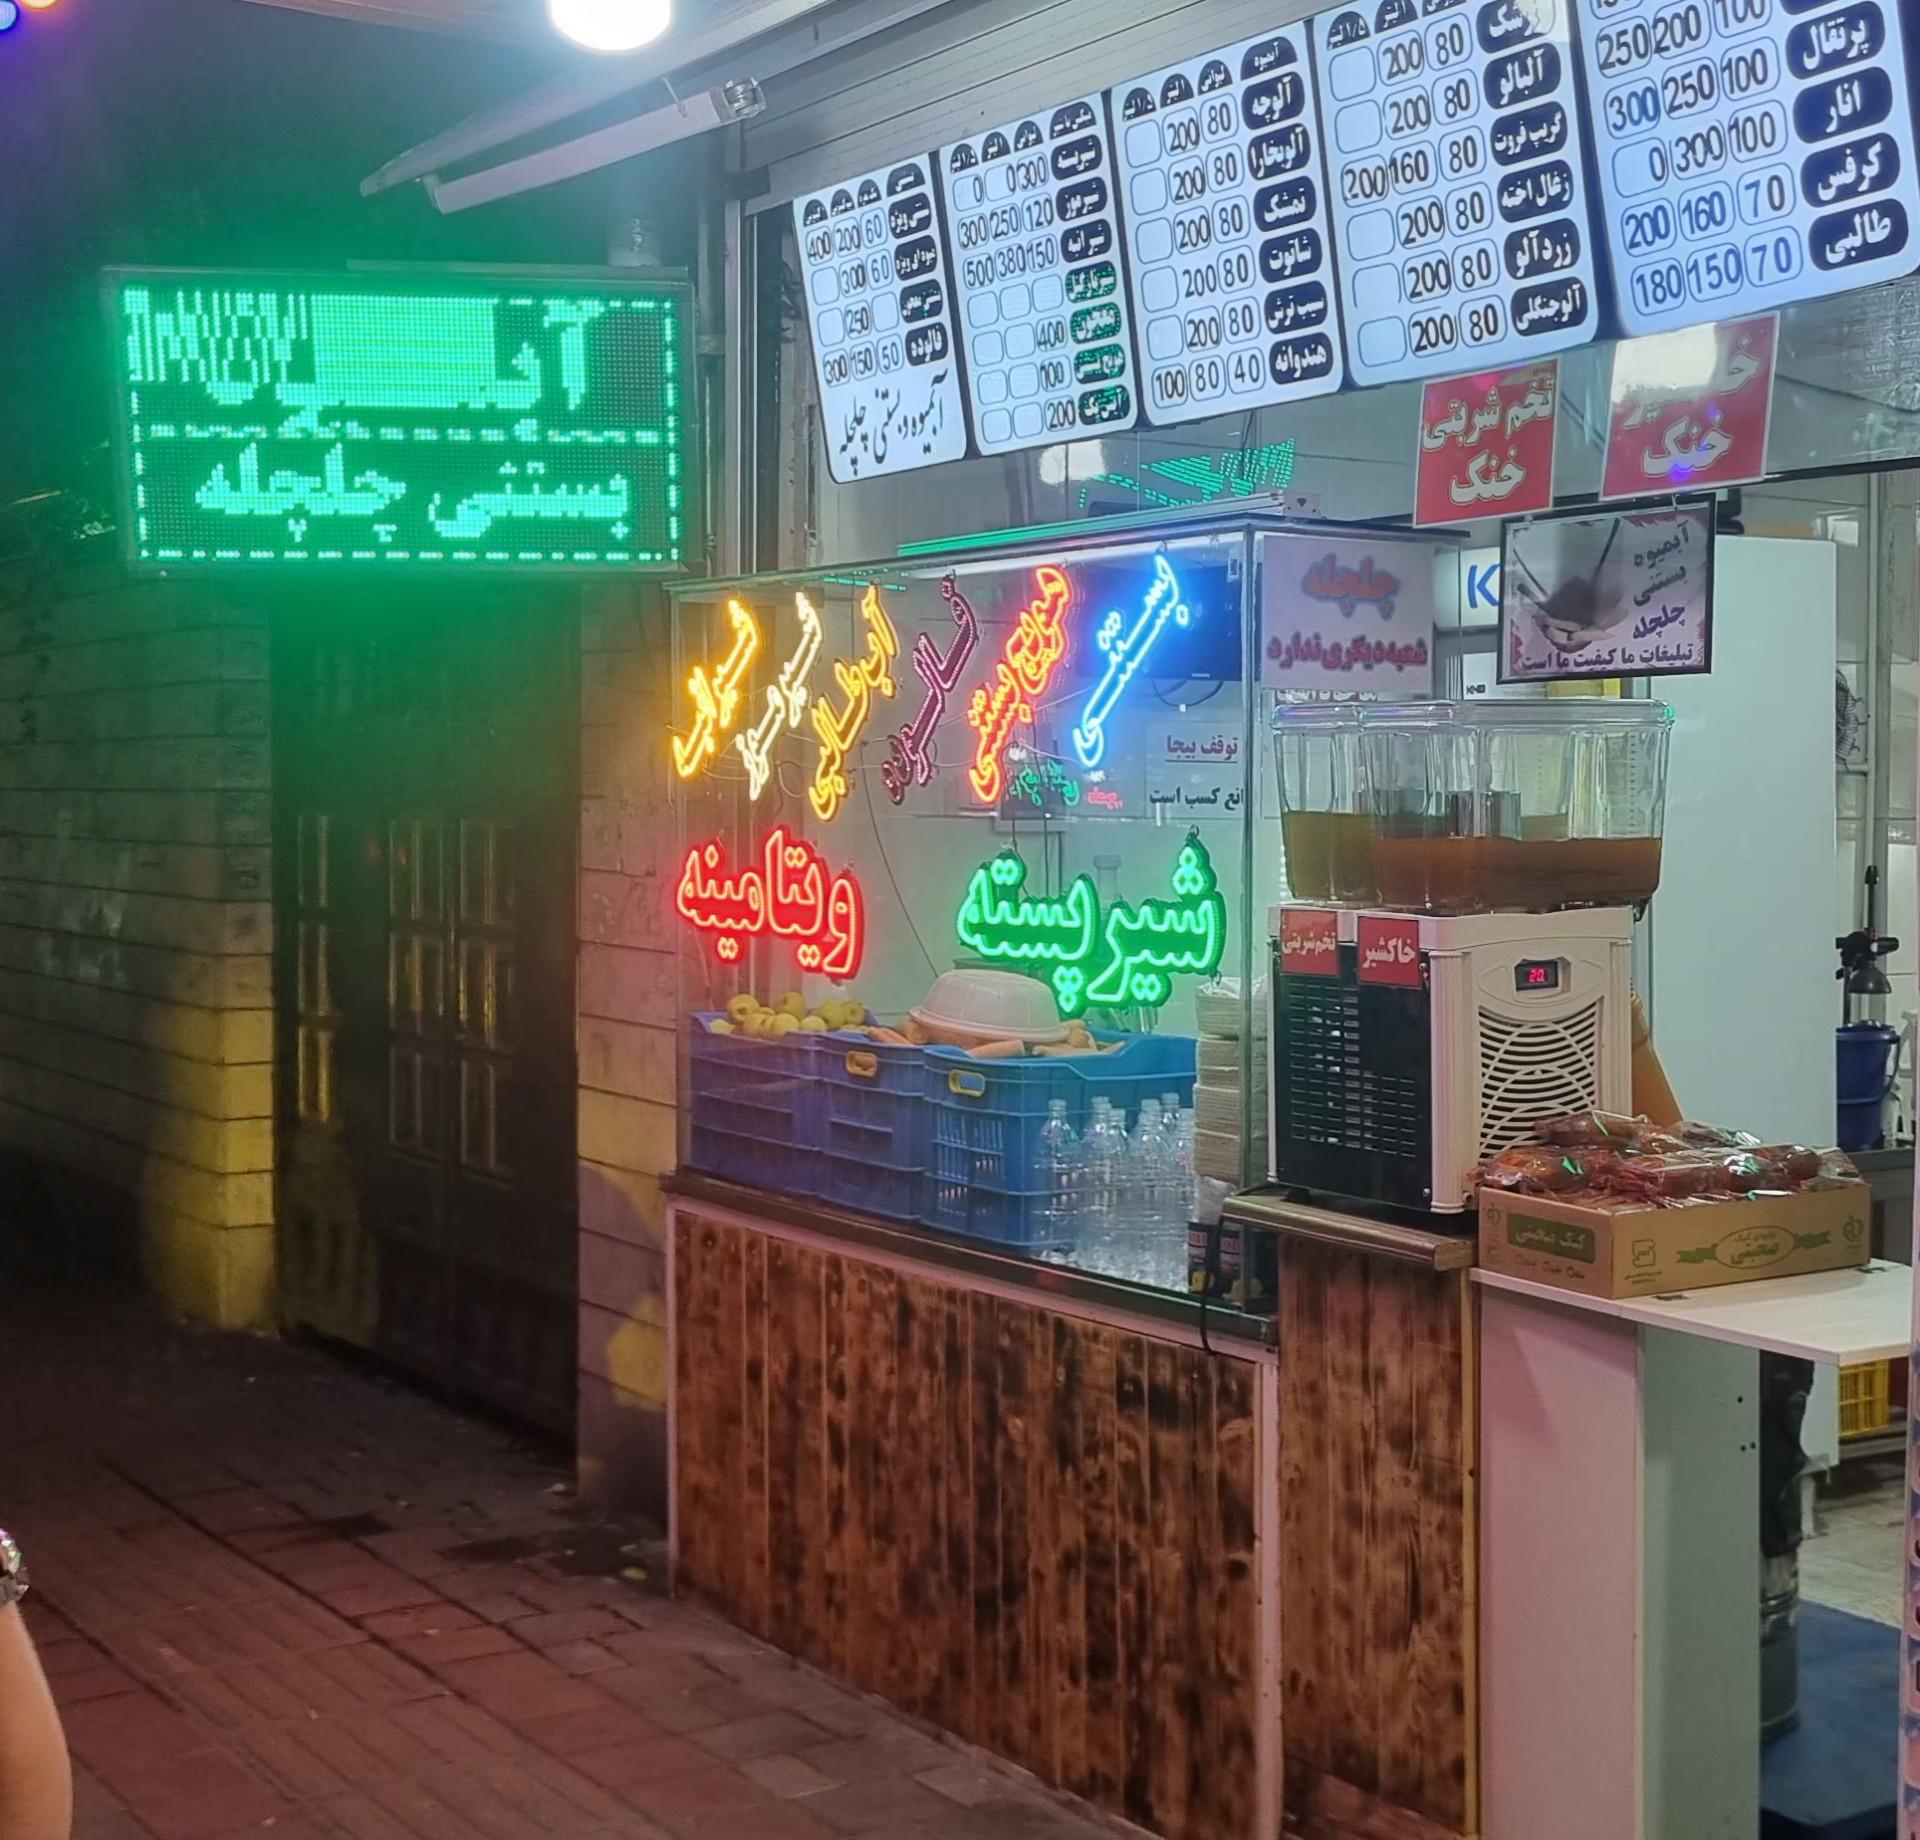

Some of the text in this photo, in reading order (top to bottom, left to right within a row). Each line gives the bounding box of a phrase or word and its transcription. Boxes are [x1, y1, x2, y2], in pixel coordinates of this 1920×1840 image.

[1436, 23, 1464, 65] 80
[1600, 23, 1649, 72] 250
[1653, 5, 1701, 54] 200
[1803, 17, 1869, 69] پرتقال
[1383, 38, 1422, 81] 200
[1499, 51, 1545, 104] آلبالو
[1721, 48, 1769, 94] 100
[1251, 75, 1292, 122] آلوچه
[1443, 78, 1470, 119] 80
[1663, 64, 1715, 113] 250
[1825, 80, 1861, 132] انار
[1208, 110, 1231, 136] 80
[1389, 94, 1431, 135] 200
[1608, 85, 1661, 131] 300
[1167, 118, 1200, 153] 200
[1494, 123, 1527, 155] فروت
[1675, 125, 1724, 172] 300
[1728, 110, 1776, 153] 100
[1016, 155, 1047, 190] 300
[1214, 158, 1237, 186] 80
[1388, 148, 1430, 185] 160
[1449, 135, 1478, 174] 80
[1649, 145, 1667, 182] 0
[1818, 141, 1882, 200] کرفس
[972, 176, 983, 203] 0
[1006, 164, 1017, 193] 0
[1174, 167, 1206, 201] 200
[1344, 165, 1386, 201] 200
[1501, 179, 1533, 209] اخته
[1745, 174, 1785, 218] 70
[989, 206, 1018, 239] 250
[1025, 197, 1054, 231] 120
[1219, 209, 1243, 237] 80
[1264, 186, 1306, 223] تمشک
[1456, 191, 1485, 231] 80
[1682, 190, 1727, 235] 160
[836, 225, 861, 252] 200
[866, 214, 882, 244] 60
[960, 215, 987, 248] 300
[1176, 217, 1210, 249] 200
[1401, 201, 1444, 246] 200
[1625, 204, 1671, 250] 200
[1825, 210, 1891, 264] طالبی
[807, 231, 831, 261] 400
[999, 244, 1027, 277] 380
[1027, 236, 1055, 270] 150
[1269, 237, 1312, 275] شاتوت
[1752, 236, 1793, 282] 70
[841, 264, 866, 295] 300
[871, 255, 889, 284] 60
[966, 254, 995, 288] 500
[1183, 264, 1216, 298] 200
[1223, 259, 1248, 288] 80
[1407, 257, 1450, 301] 200
[1461, 248, 1492, 289] 80
[1636, 264, 1683, 308] 180
[1687, 248, 1743, 294] 150
[846, 306, 869, 335] 250
[1037, 320, 1065, 350] 400
[1187, 315, 1220, 348] 200
[1228, 309, 1254, 338] 80
[1411, 315, 1454, 353] 200
[1469, 303, 1499, 342] 80
[851, 346, 873, 376] 150
[881, 341, 900, 370] 50
[910, 325, 943, 362] فالوده
[1274, 346, 1326, 378] هندوانه
[824, 354, 848, 385] 300
[1040, 361, 1064, 390] 100
[1155, 369, 1185, 400] 100
[1195, 361, 1219, 393] 80
[1234, 354, 1260, 385] 40
[1048, 400, 1076, 430] 200
[1421, 373, 1557, 454] تخم شربتی
[1642, 410, 1735, 478] خنک
[194, 441, 628, 543] بستنی چلچله
[1449, 445, 1527, 506] خنک
[1633, 520, 1690, 570] آبمیوه
[1303, 552, 1401, 620] چلچله
[1633, 565, 1687, 608] بستنی
[1005, 565, 1071, 696] هویج
[1633, 603, 1687, 640] چلچله
[1072, 553, 1190, 768] بستنی
[1521, 643, 1694, 672] تبلیغات ما کیفیت ما است
[735, 591, 823, 801] شیر موز
[808, 581, 897, 821] آب طالبی
[880, 576, 979, 806] فالوده
[968, 661, 1034, 803] بستنی
[1166, 734, 1239, 761] توقف بیجا
[1149, 786, 1181, 805] است
[1184, 787, 1221, 809] کسب
[1224, 786, 1244, 811] انع
[677, 828, 858, 976] ویتامینه
[957, 845, 1227, 1013] شیر پسته
[1362, 936, 1417, 968] خاکشیر
